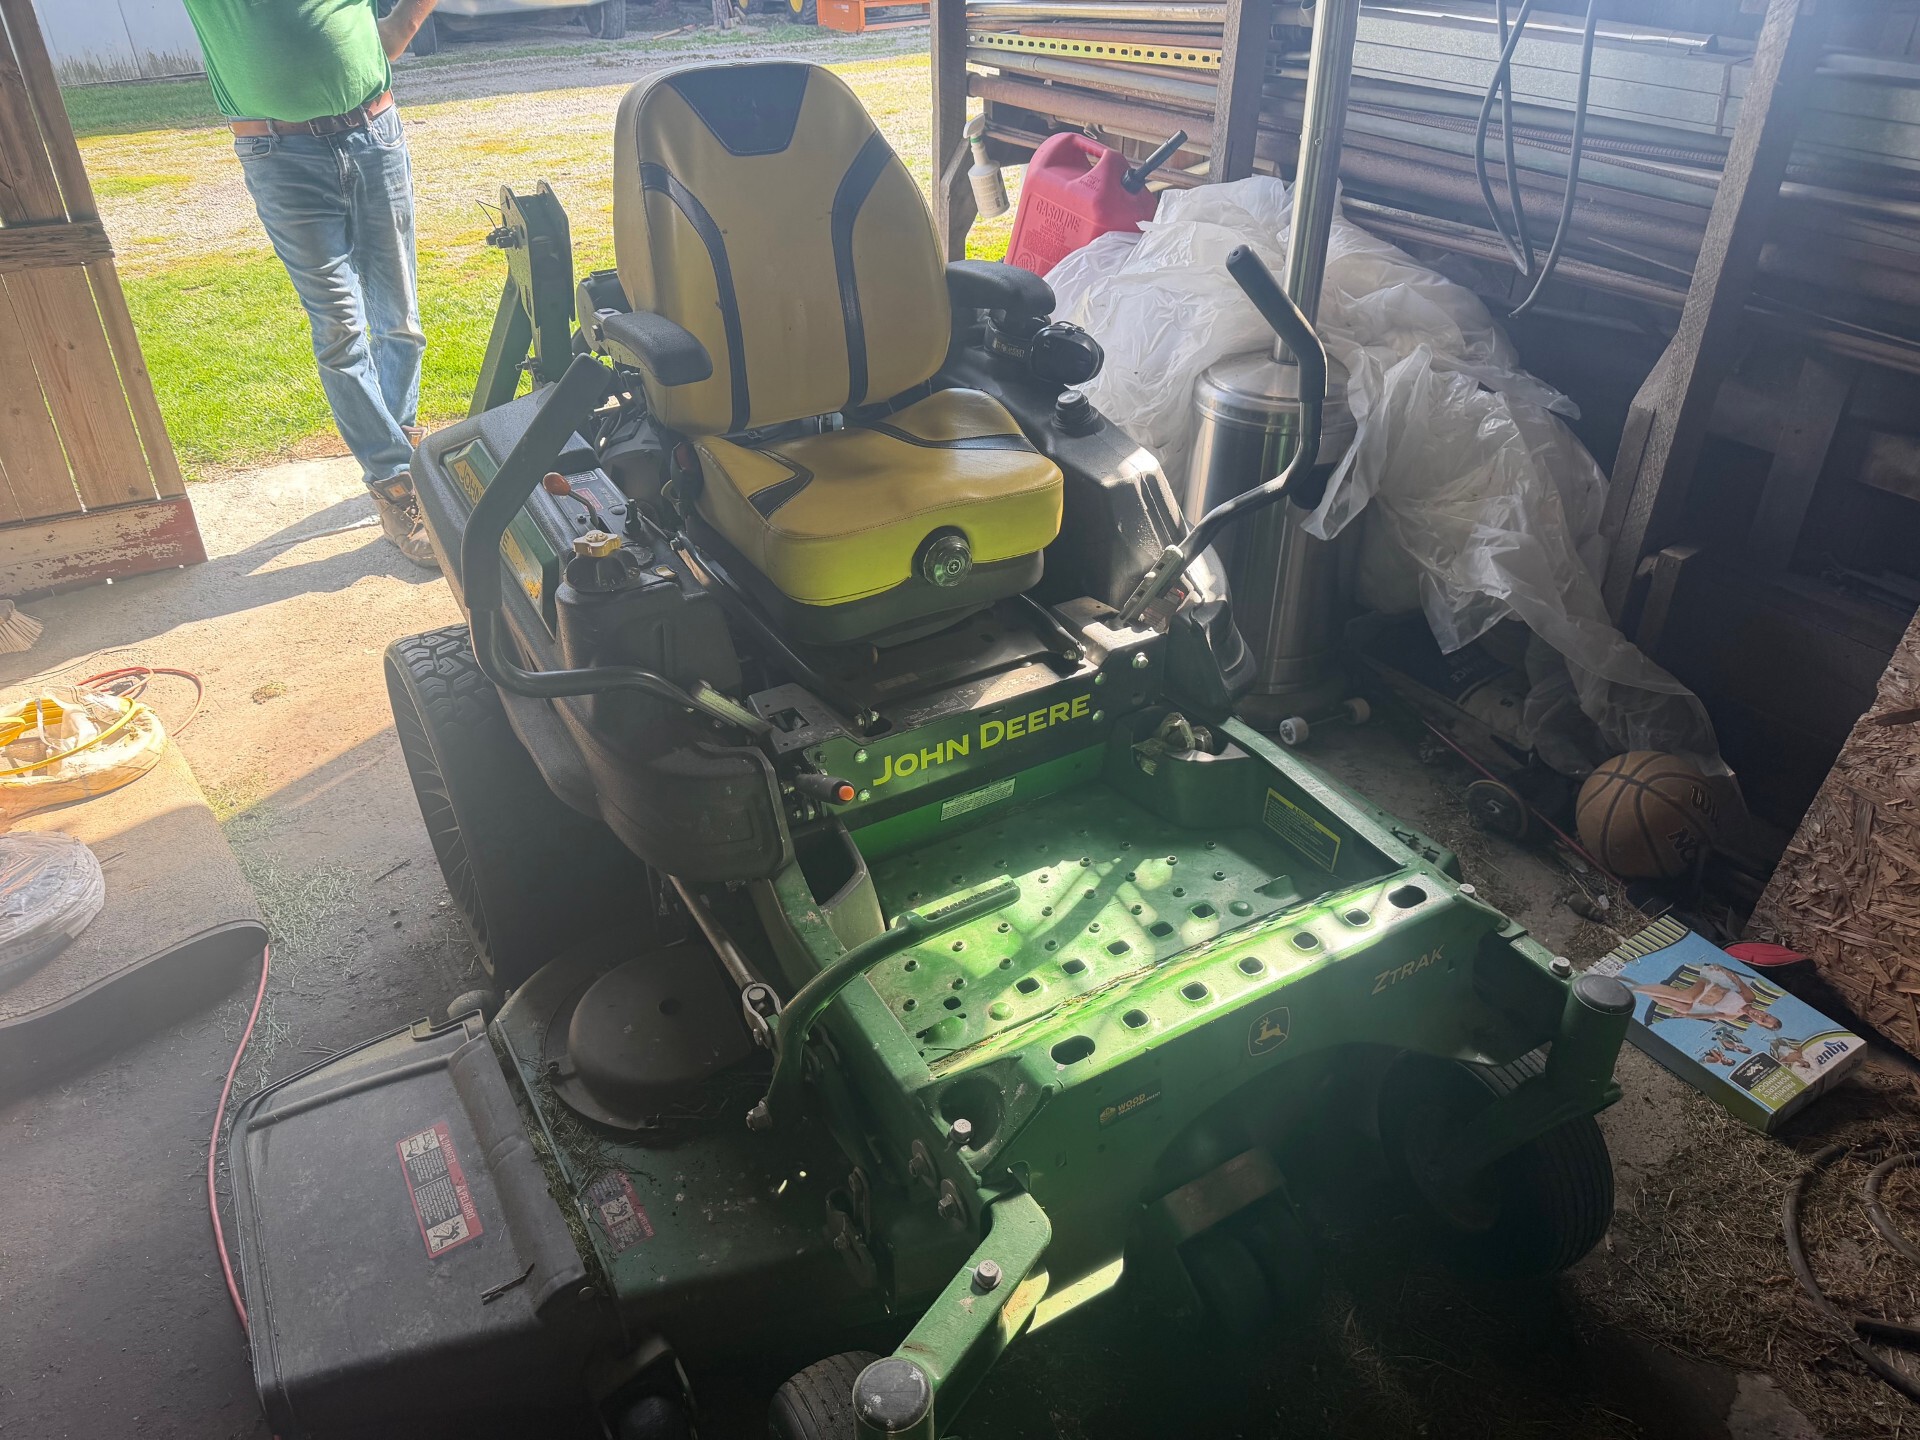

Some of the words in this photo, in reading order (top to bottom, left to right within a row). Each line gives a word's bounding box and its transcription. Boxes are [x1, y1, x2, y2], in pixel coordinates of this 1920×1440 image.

[1036, 199, 1080, 233] GASOLINE
[872, 733, 970, 787] JOHN
[980, 694, 1090, 749] DEERE
[1371, 943, 1446, 996] ZTRAK
[1815, 1041, 1849, 1065] Aqua
[1755, 1070, 1784, 1092] HAMMOCK
[1762, 1075, 1791, 1098] MONTEREY
[1770, 1081, 1796, 1101] PREMIUM
[1118, 1093, 1146, 1112] WOOD
[441, 1139, 456, 1165] DANGER
[459, 1191, 476, 1220] PELIGRO
